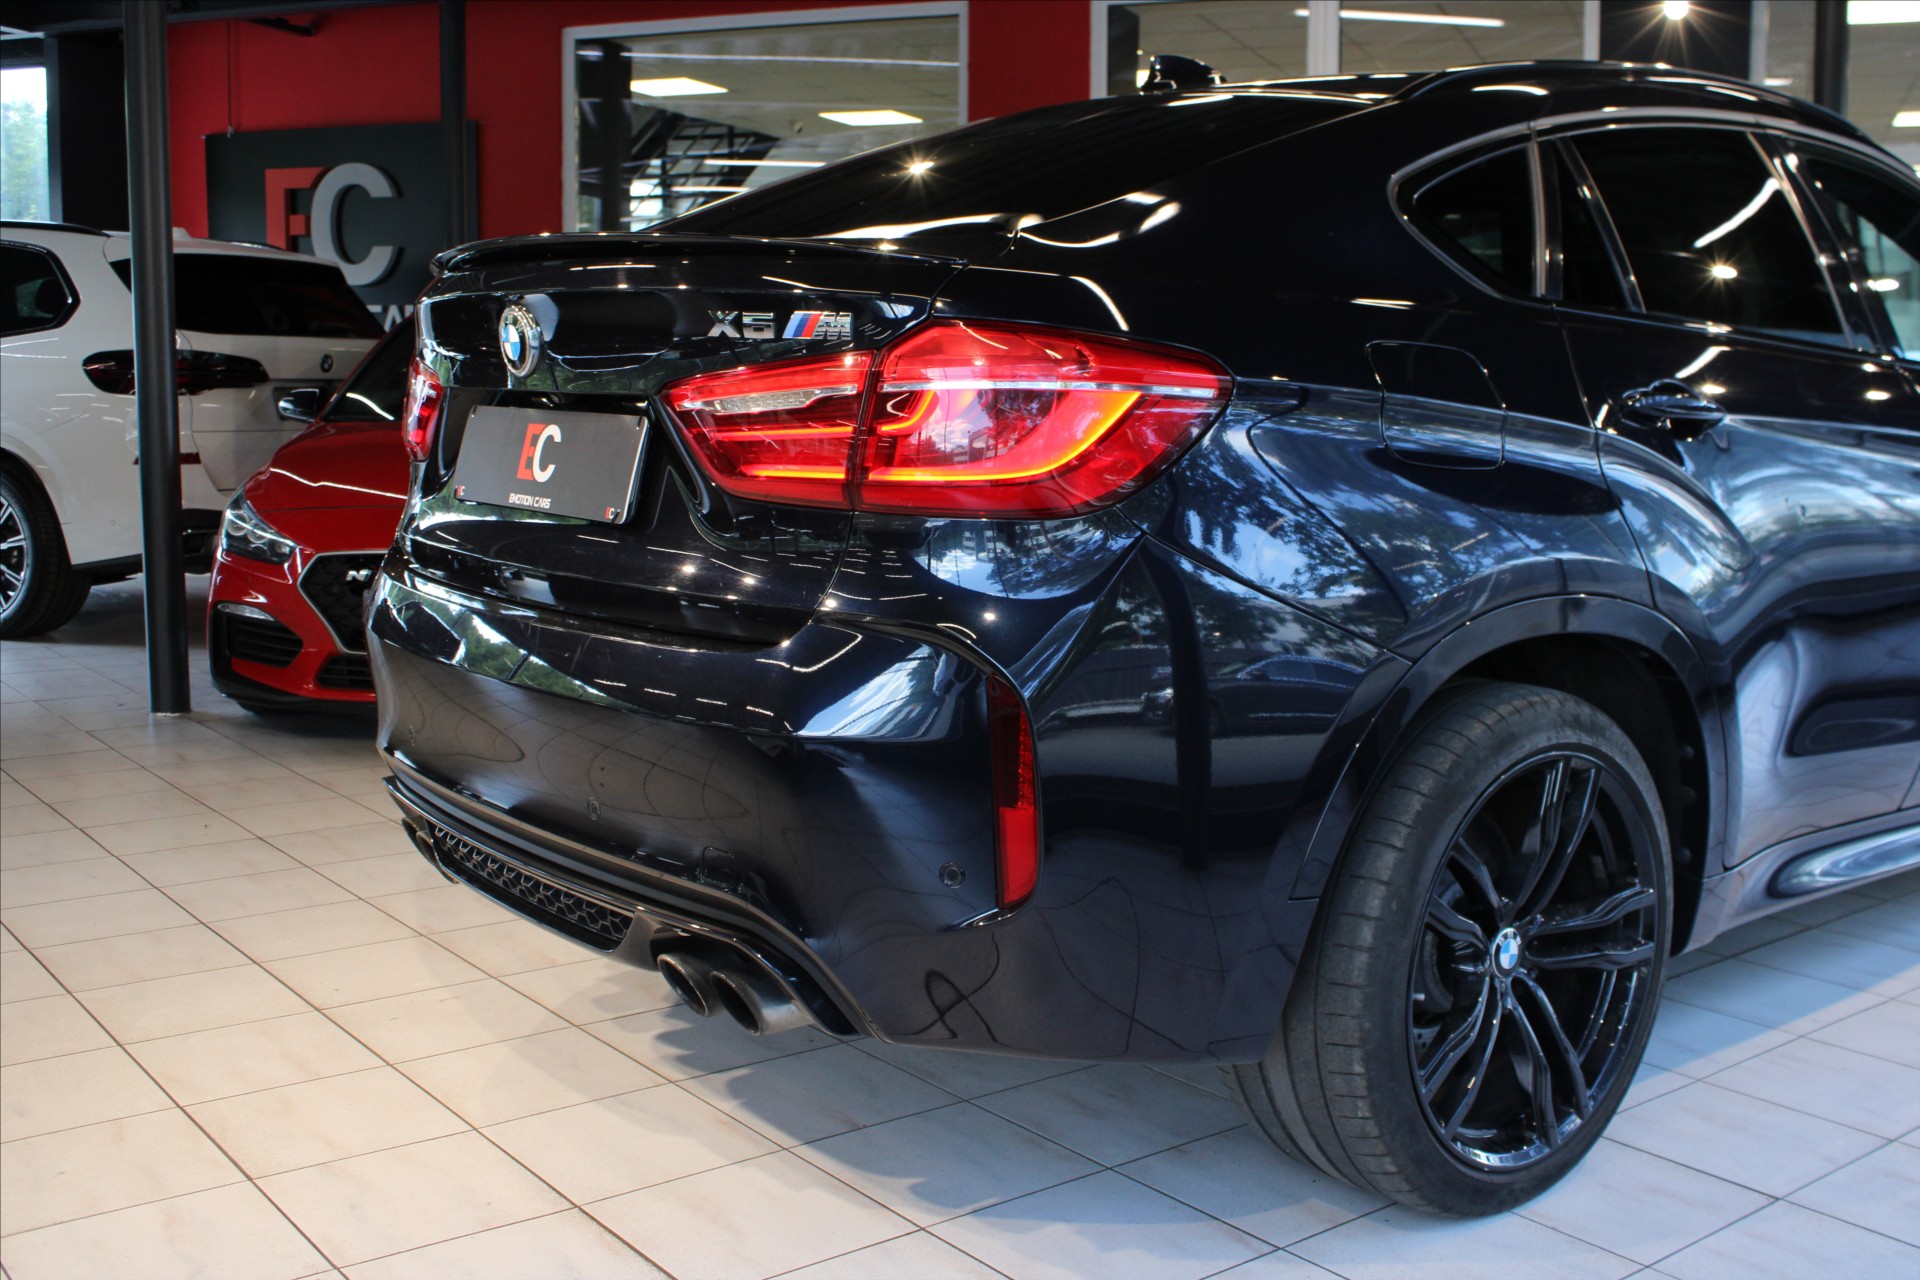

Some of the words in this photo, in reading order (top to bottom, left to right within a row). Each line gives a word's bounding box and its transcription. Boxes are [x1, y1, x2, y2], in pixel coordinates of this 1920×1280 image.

[708, 311, 775, 339] X6
[517, 423, 562, 483] EC
[508, 493, 534, 506] EMOTION
[534, 497, 551, 509] CARS
